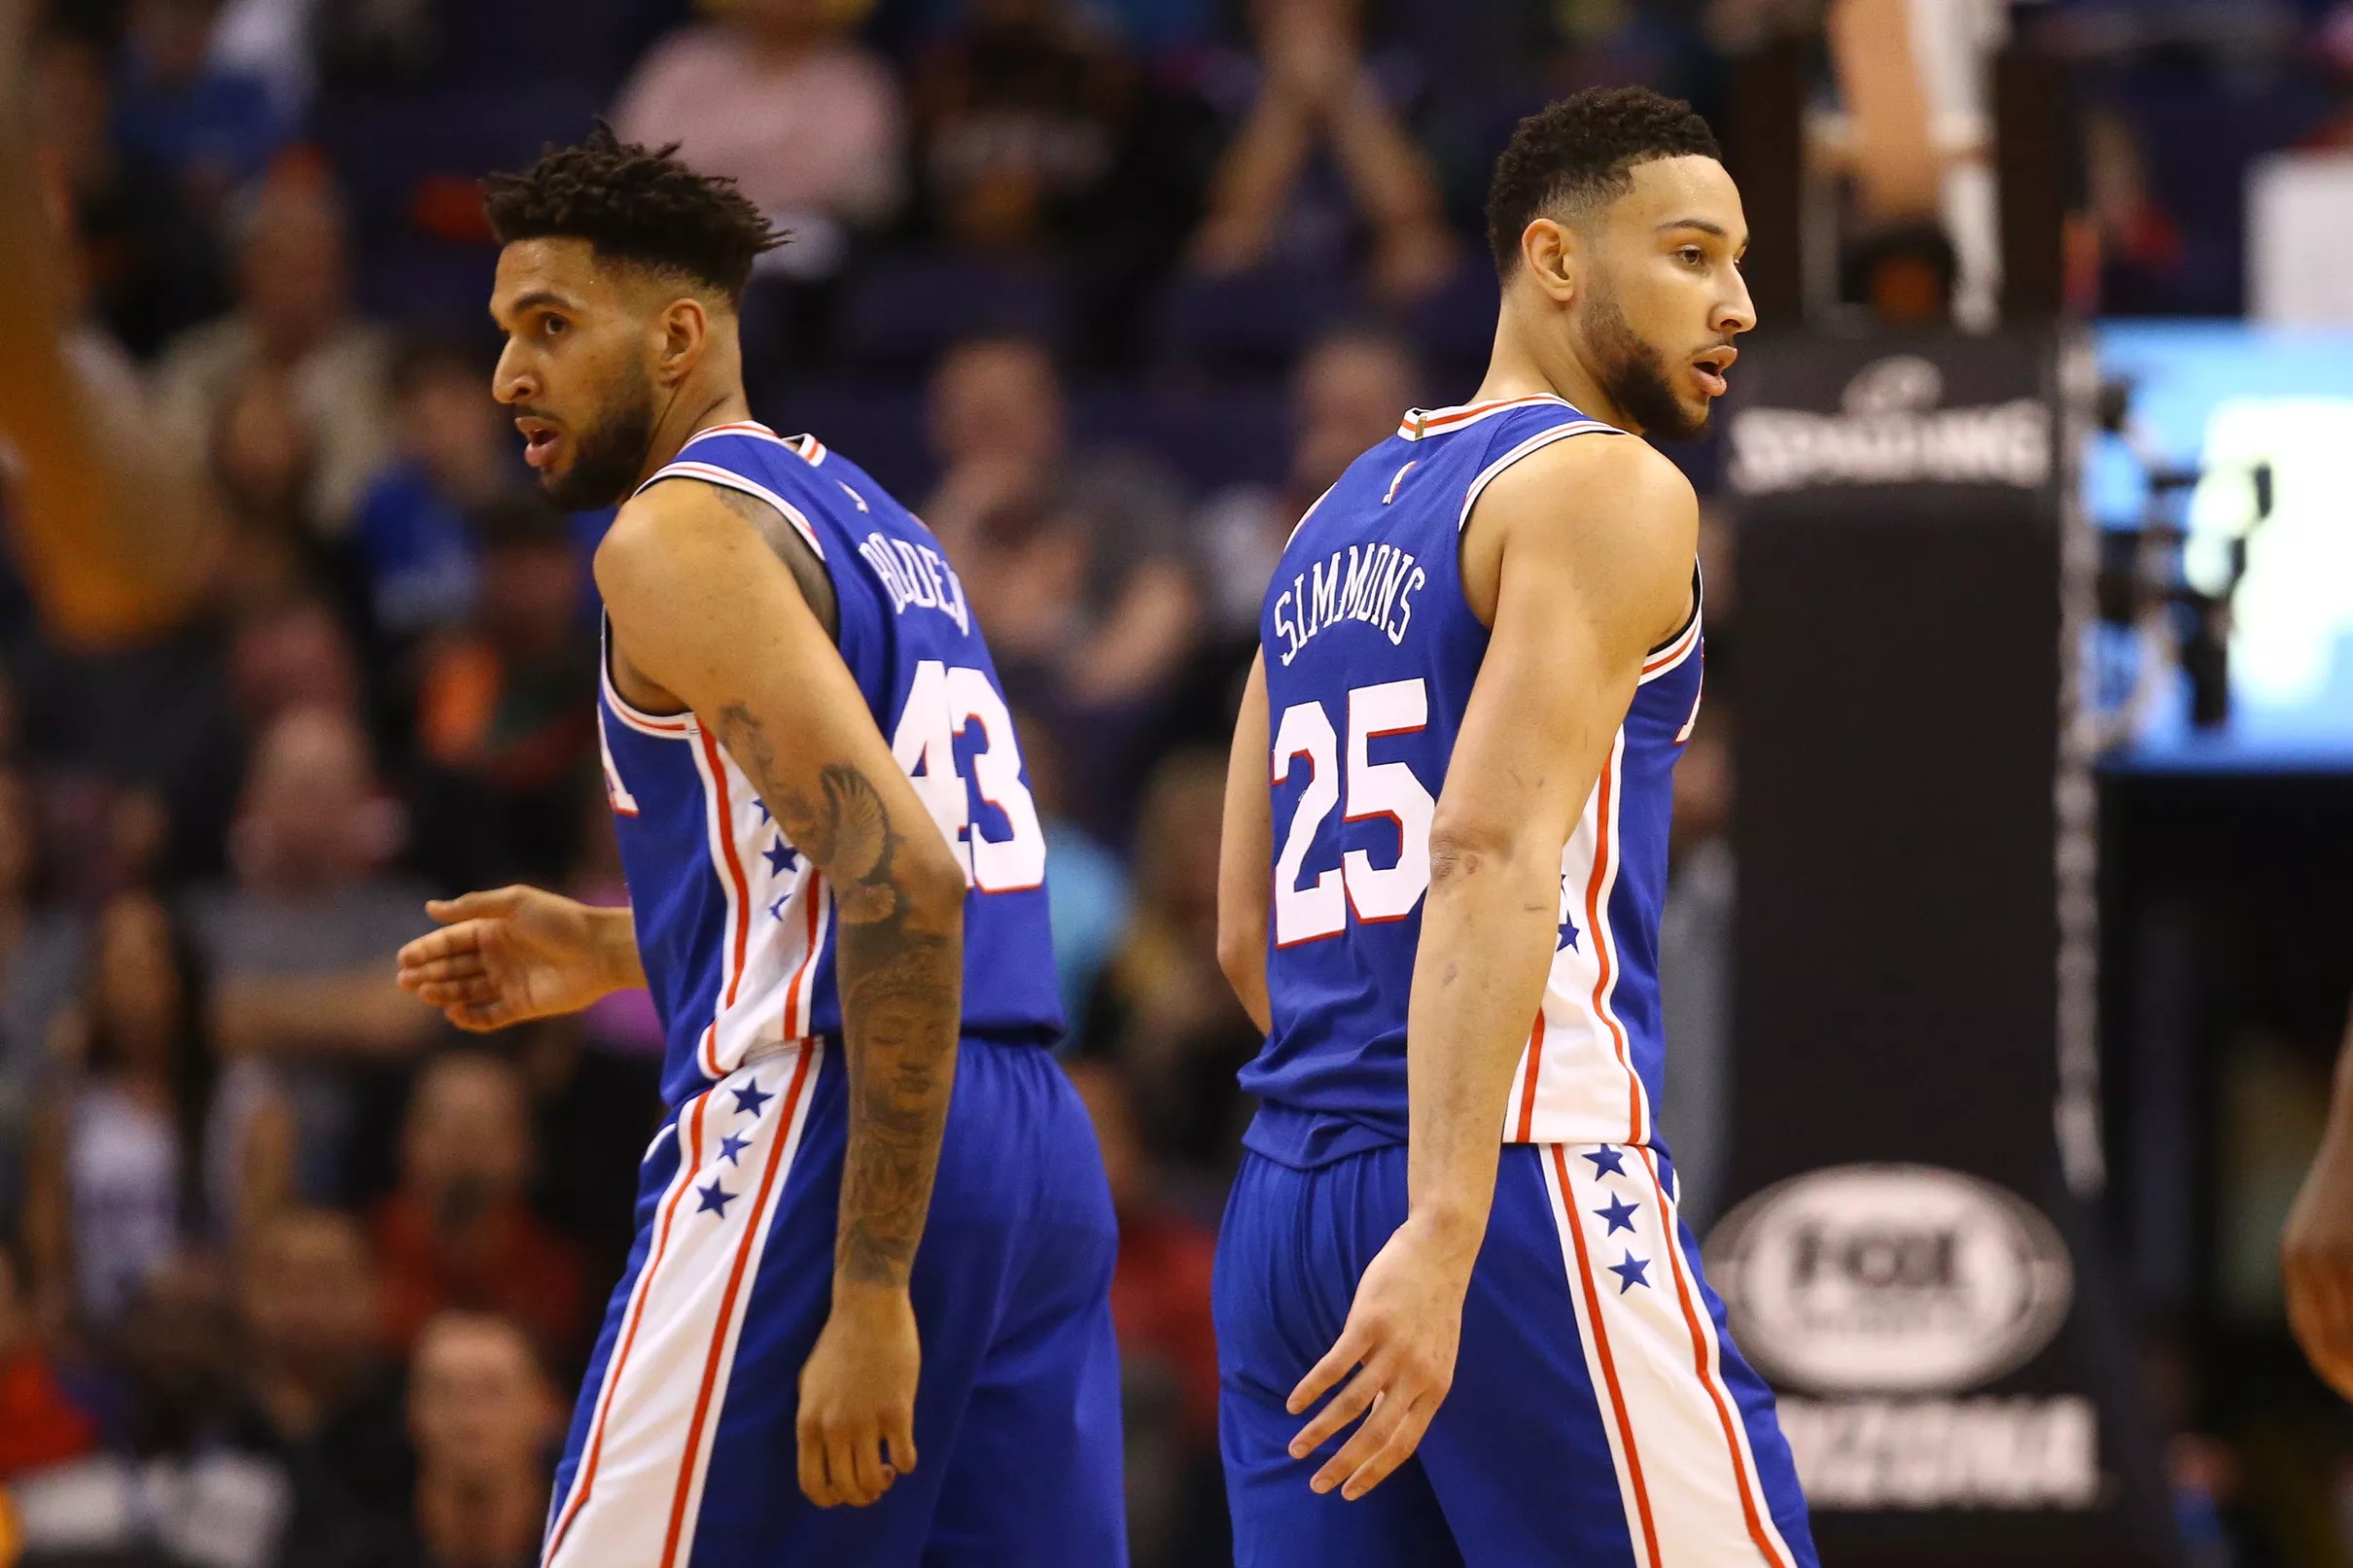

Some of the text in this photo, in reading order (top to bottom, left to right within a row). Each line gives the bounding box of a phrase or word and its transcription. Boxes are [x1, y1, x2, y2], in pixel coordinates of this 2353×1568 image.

[1274, 542, 1425, 667] SIMMONS
[892, 660, 1047, 894] 43
[1272, 678, 1436, 950] 25
